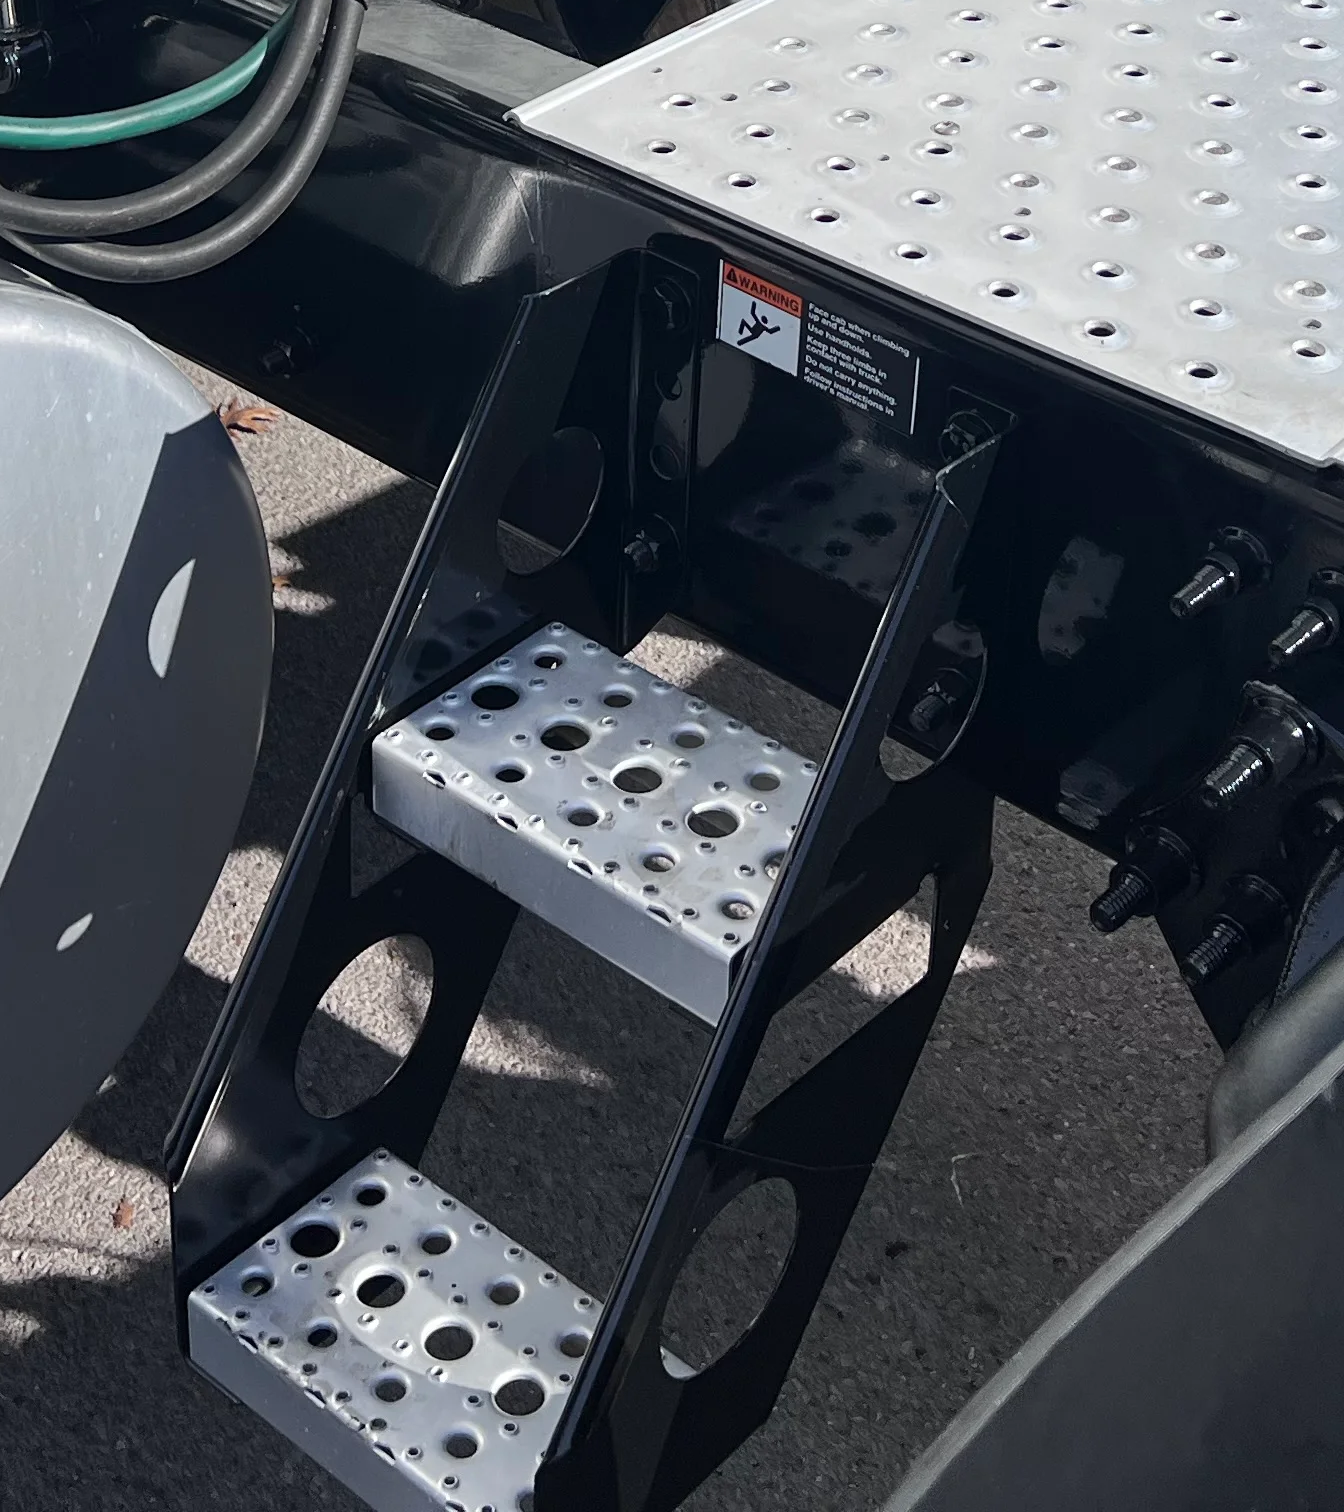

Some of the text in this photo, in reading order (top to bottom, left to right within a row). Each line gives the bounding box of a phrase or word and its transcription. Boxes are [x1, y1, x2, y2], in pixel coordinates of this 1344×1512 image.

[739, 275, 800, 313] WARNING
[807, 322, 872, 359] Use handholds.
[808, 311, 864, 343] up and down.
[809, 302, 910, 358] Face cab when climbing
[806, 343, 882, 386] contact with truck.
[807, 334, 887, 380] Keep three limbs in
[803, 375, 869, 412] driver's manual.
[804, 366, 895, 417] Follow instructions in
[805, 354, 897, 406] Do not carry anything.
